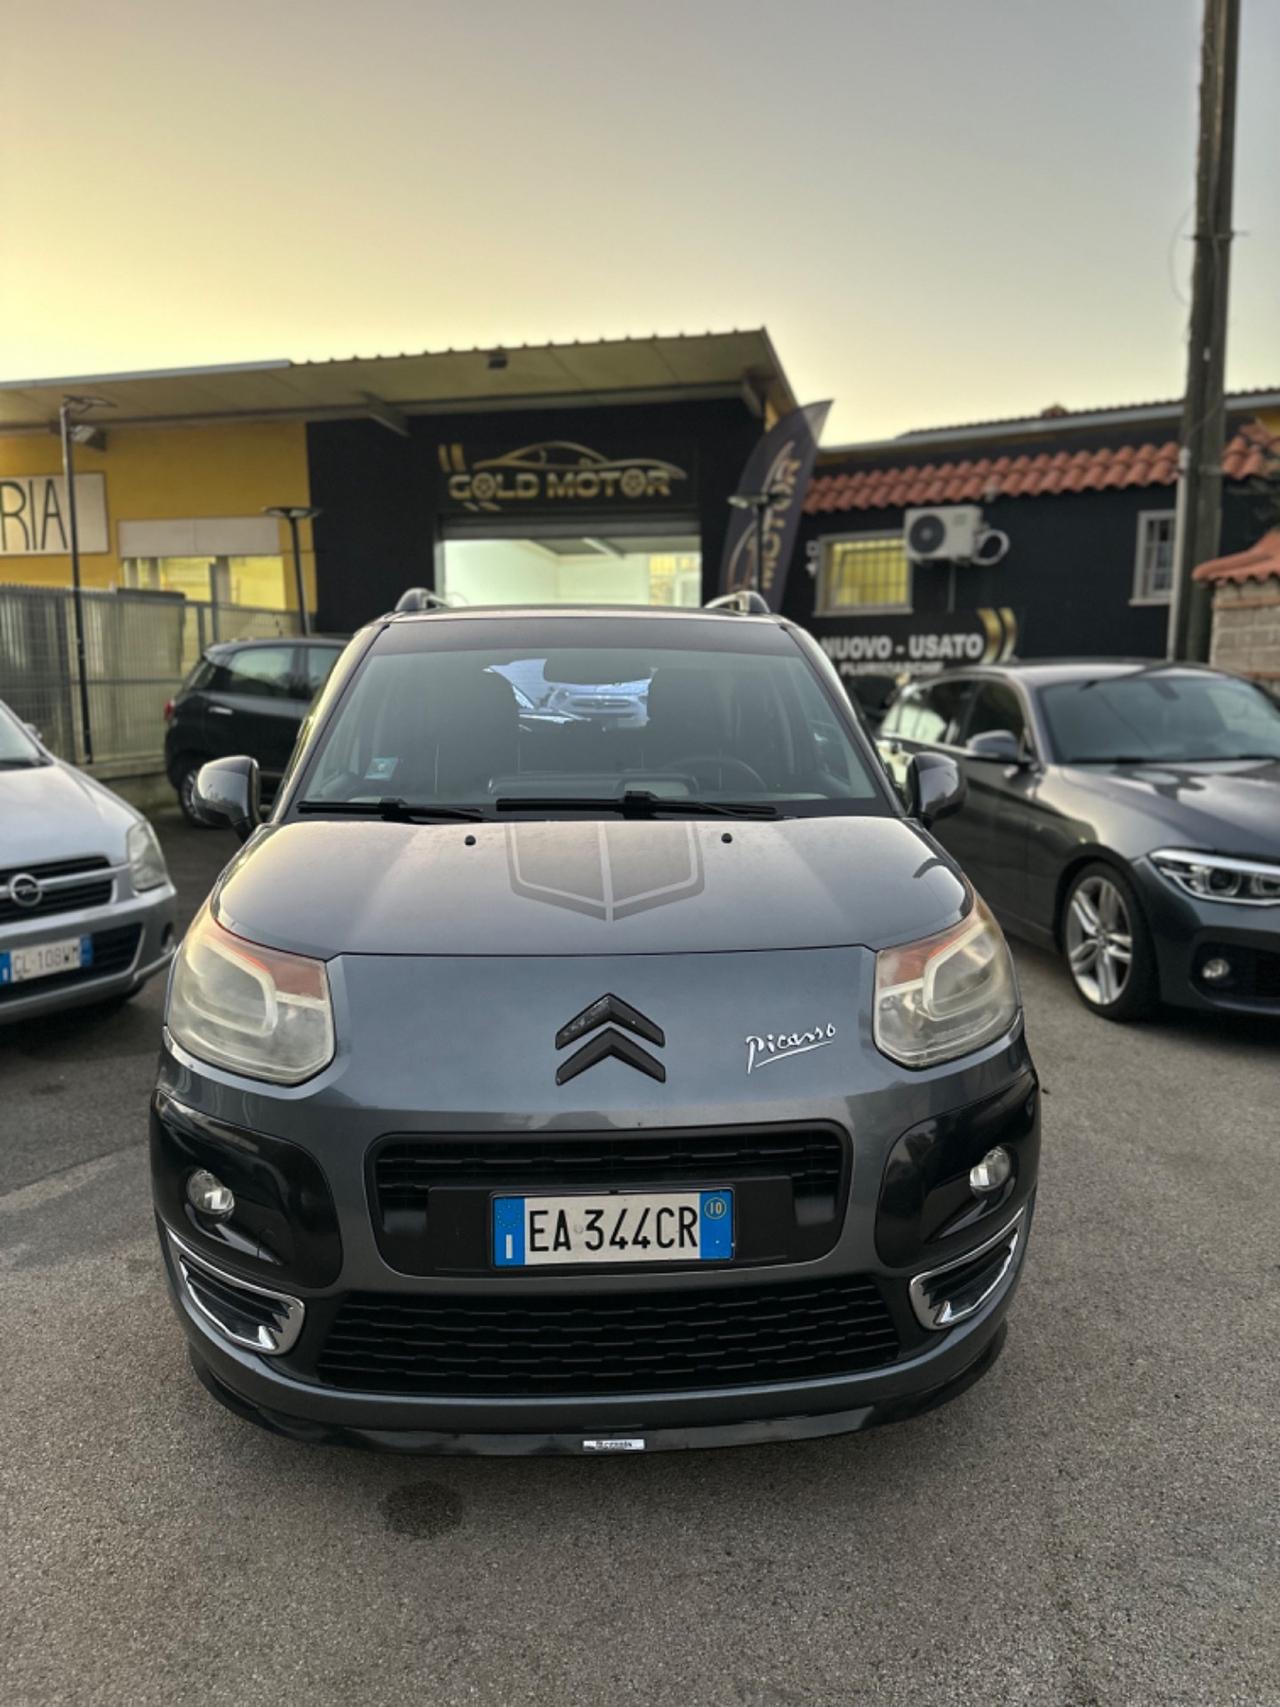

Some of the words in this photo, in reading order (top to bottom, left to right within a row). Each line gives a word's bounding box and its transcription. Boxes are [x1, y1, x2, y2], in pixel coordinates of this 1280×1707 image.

[450, 472, 539, 498] GOLD
[547, 468, 671, 498] MOTOR
[820, 635, 892, 659] NUOVO
[908, 633, 984, 658] USATO
